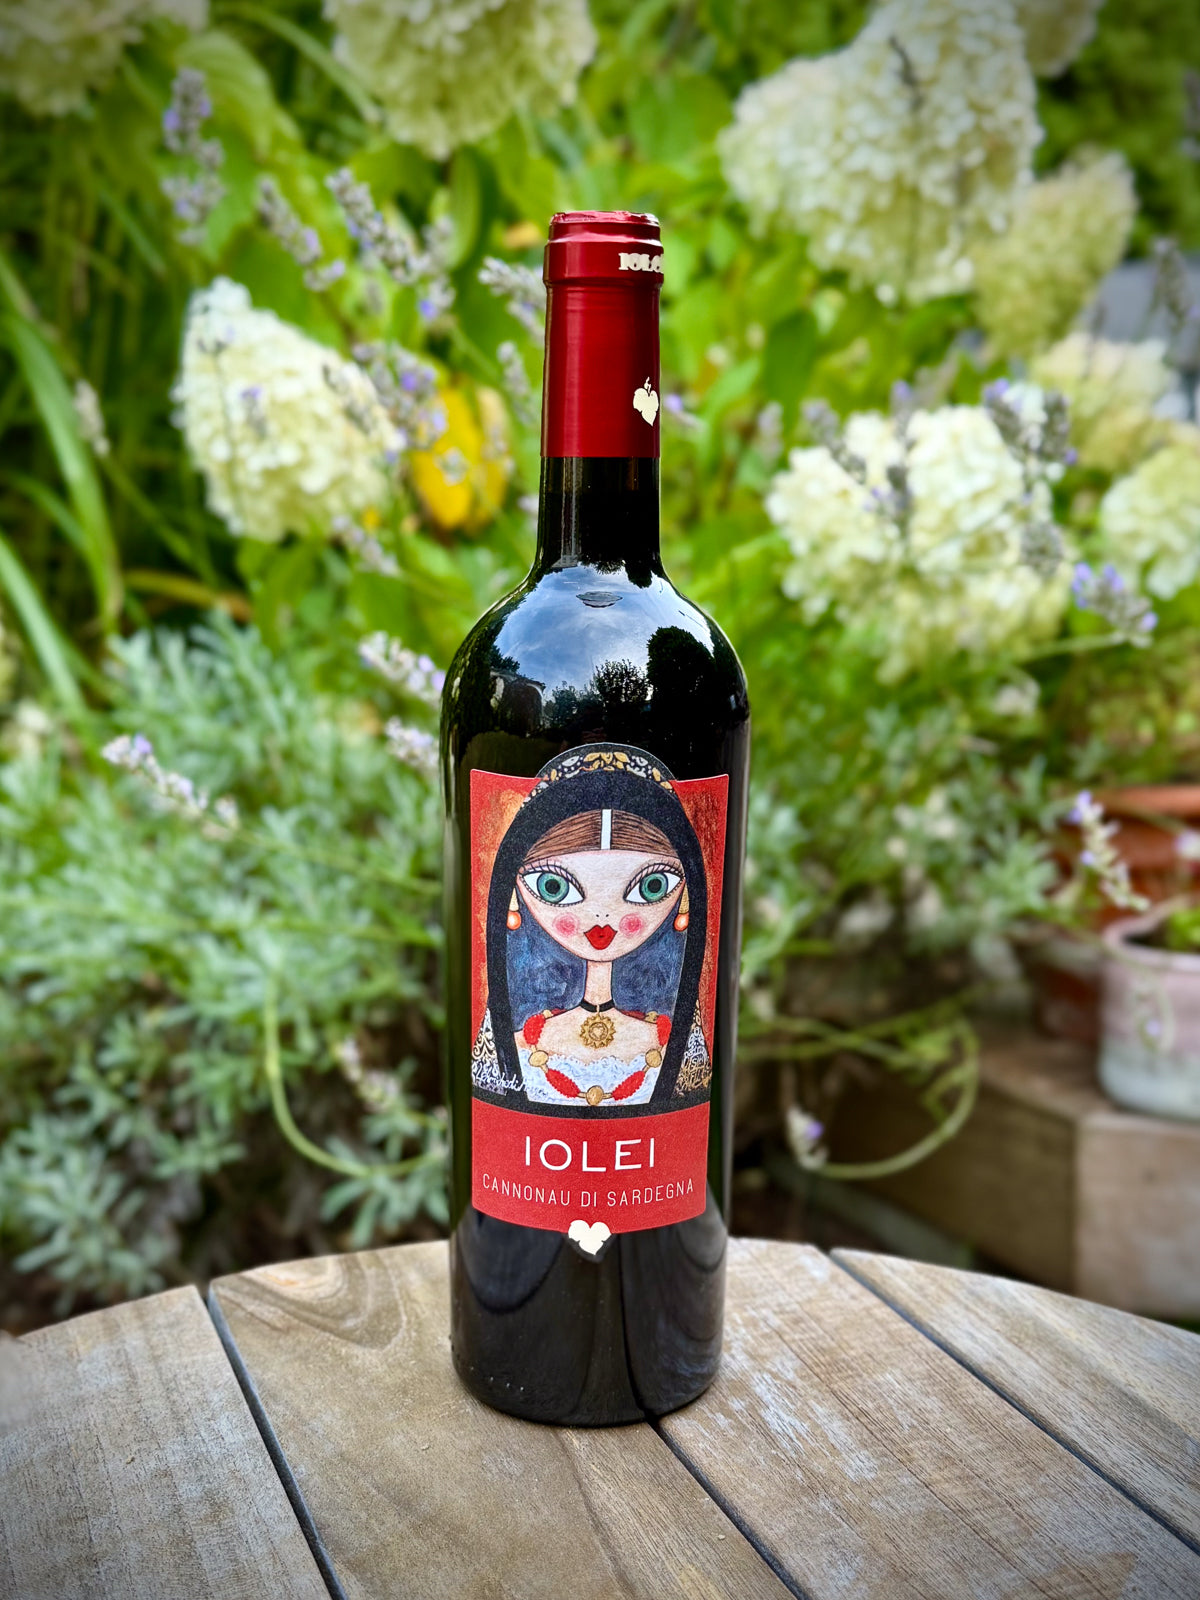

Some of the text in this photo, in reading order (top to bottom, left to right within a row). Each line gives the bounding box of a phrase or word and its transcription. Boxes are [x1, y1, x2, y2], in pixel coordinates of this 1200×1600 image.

[525, 1136, 655, 1172] IOLEI
[482, 1173, 694, 1207] CANNONAU DI SARDEGNA
